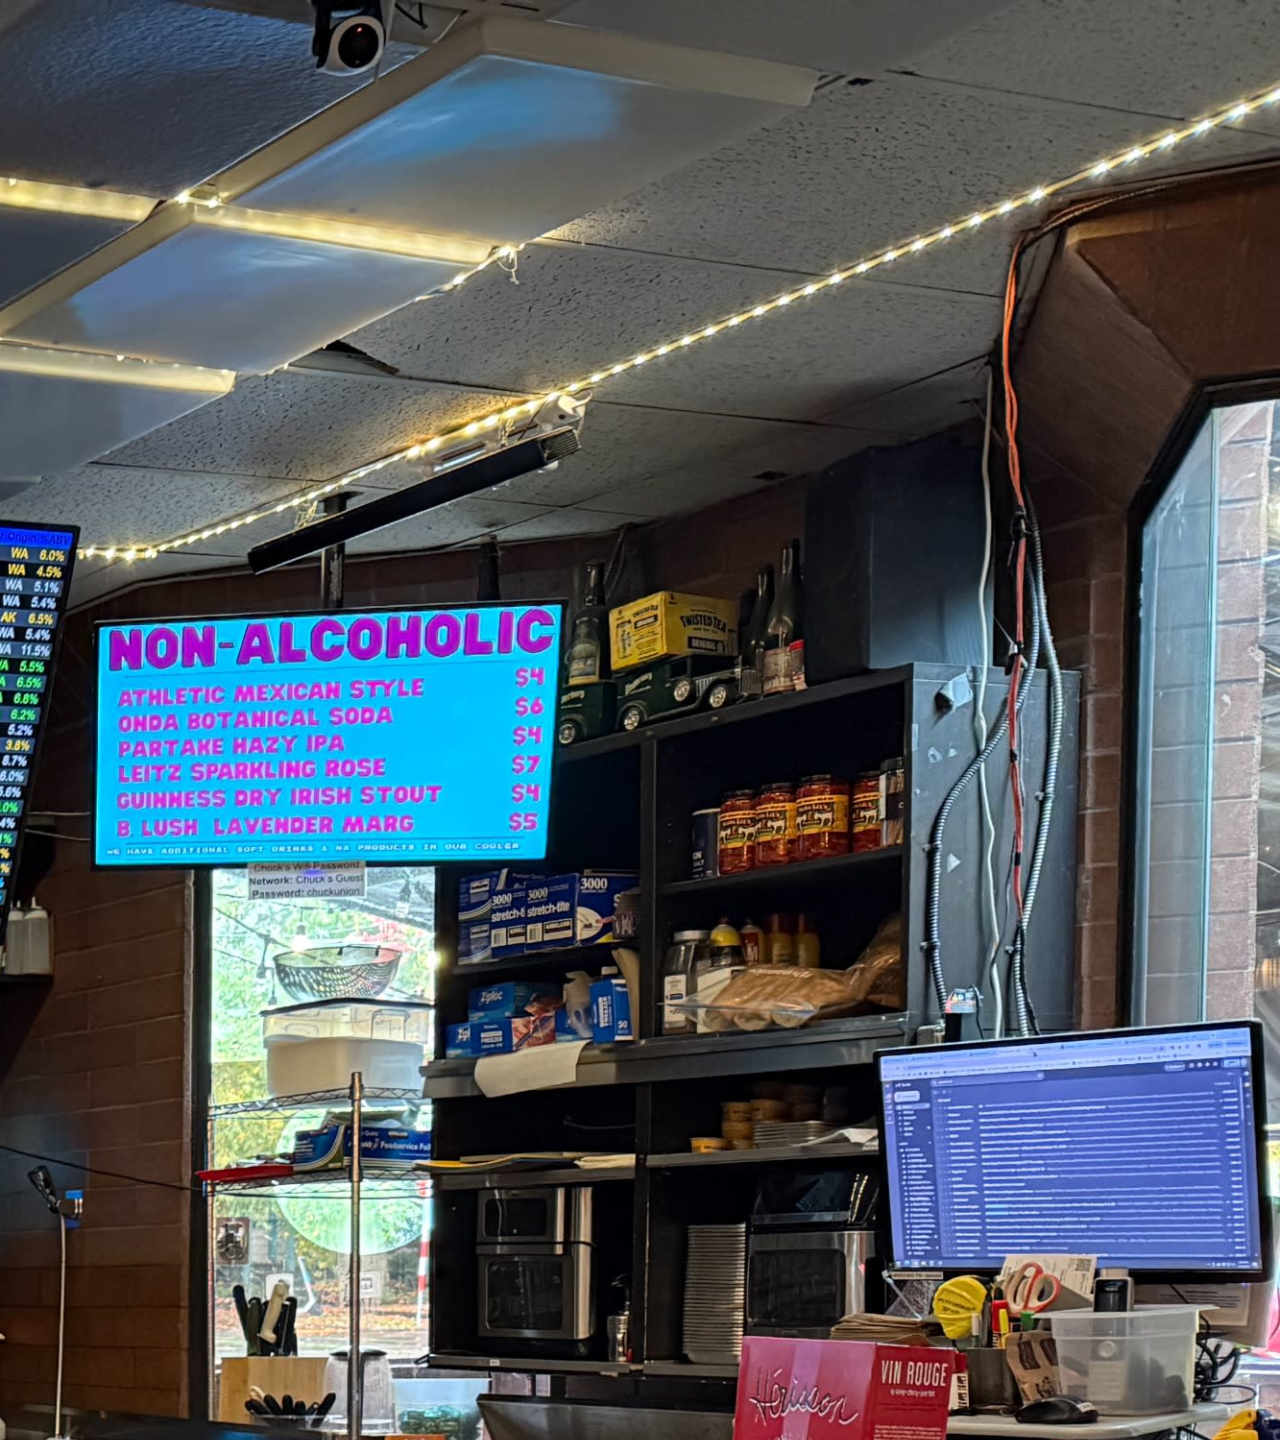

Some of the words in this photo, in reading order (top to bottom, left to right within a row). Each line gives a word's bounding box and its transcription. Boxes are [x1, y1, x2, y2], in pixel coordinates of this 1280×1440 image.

[109, 608, 556, 671] NON-ALCOHOLIC
[118, 687, 225, 706] ATHLETIC
[234, 682, 341, 702] MEXICAN
[350, 678, 425, 698] STYLE
[515, 667, 546, 686] $4
[118, 714, 179, 733] ONDA
[187, 709, 319, 730] BOTANICAL
[329, 707, 393, 725] SODA
[515, 698, 545, 716] $6
[118, 738, 225, 757] PARTAKE
[232, 736, 296, 754] HAZY
[307, 735, 345, 752] IPA
[513, 726, 543, 745] $4
[118, 765, 182, 783] LEITZ
[191, 760, 317, 780] SPARKLING
[325, 758, 385, 777] ROSE
[512, 756, 541, 774] $7
[117, 789, 226, 809] GUINNESS
[234, 788, 281, 807] DRY
[290, 787, 351, 805] IRISH
[360, 785, 442, 803] STOUT
[511, 785, 541, 803] $4
[117, 820, 133, 837] B.
[142, 819, 198, 837] LUSH
[214, 817, 333, 835] LAVENDER
[342, 815, 415, 833] MARG
[509, 813, 538, 831] $5
[527, 888, 548, 900] 3000
[580, 878, 608, 889] 3000
[881, 1360, 901, 1385] VIN
[906, 1361, 949, 1387] ROUGE
